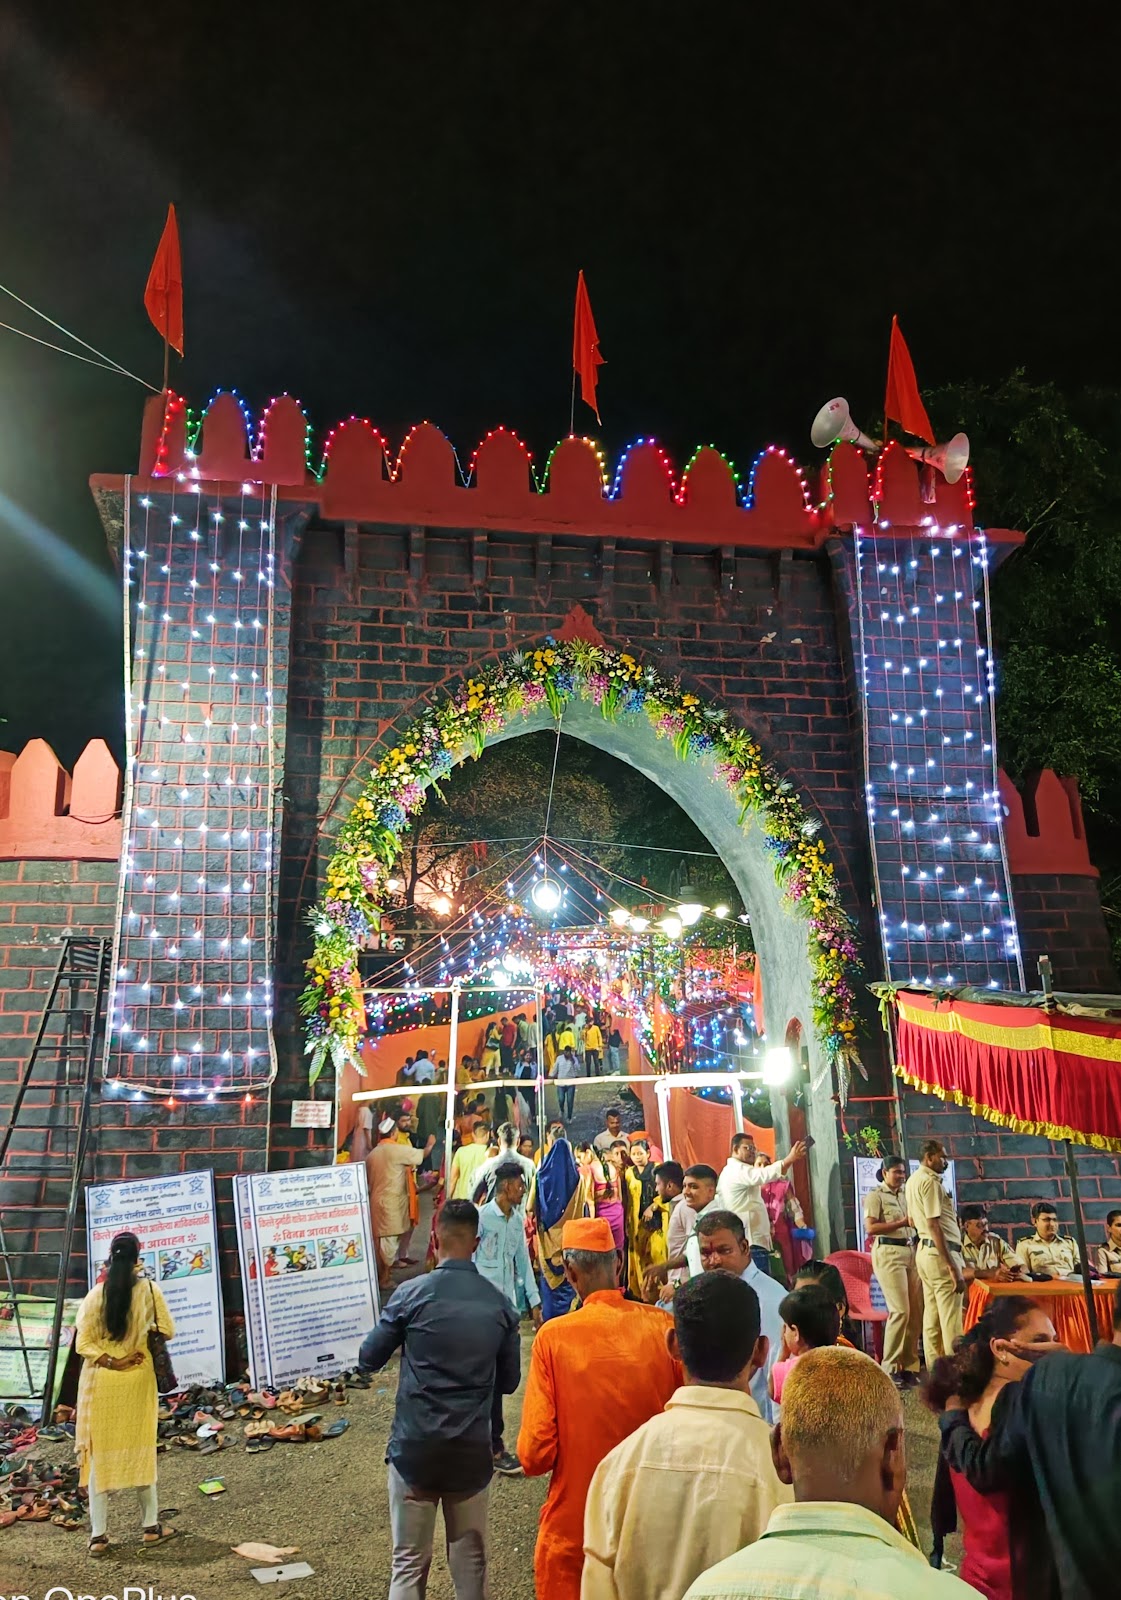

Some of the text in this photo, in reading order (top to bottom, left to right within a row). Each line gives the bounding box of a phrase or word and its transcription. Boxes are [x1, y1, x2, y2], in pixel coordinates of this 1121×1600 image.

[93, 1213, 123, 1225] बाजारपेठ
[124, 1209, 147, 1221] पोलीस
[166, 1203, 192, 1214] कल्याण
[306, 1225, 339, 1237] आवाहन
[147, 1234, 185, 1249] आवाहन
